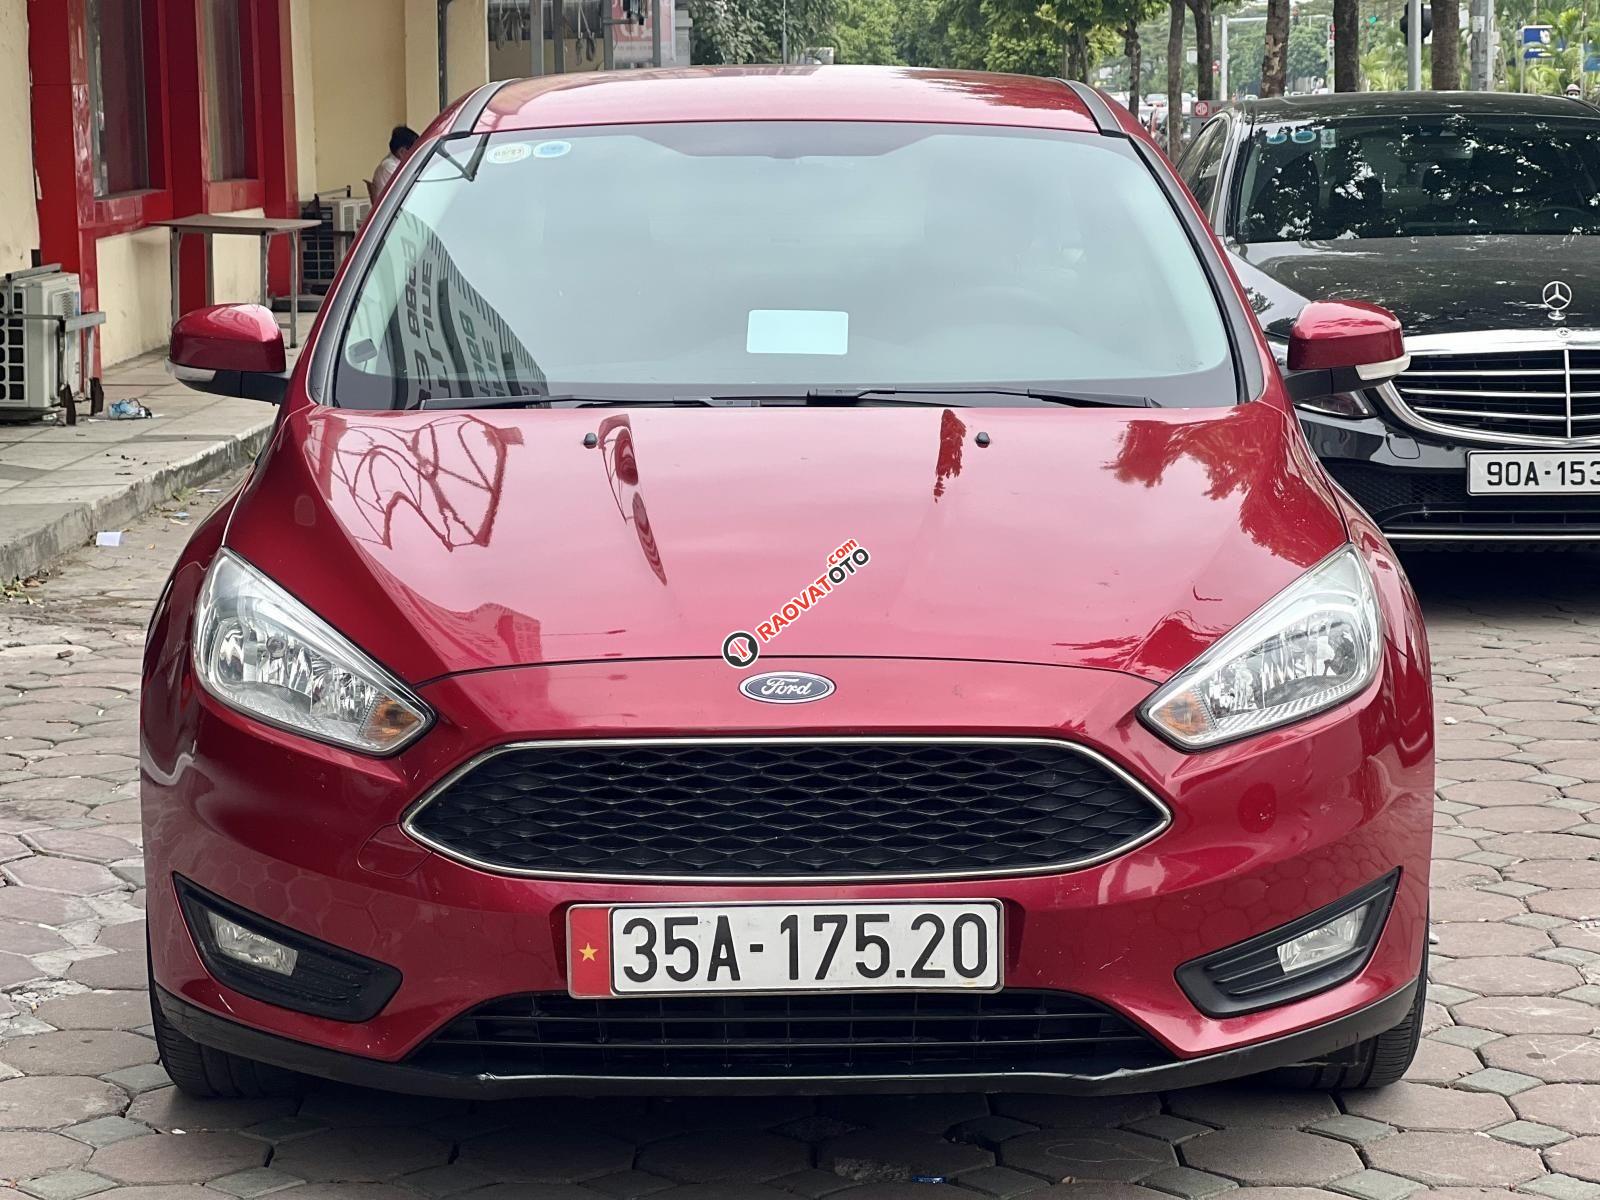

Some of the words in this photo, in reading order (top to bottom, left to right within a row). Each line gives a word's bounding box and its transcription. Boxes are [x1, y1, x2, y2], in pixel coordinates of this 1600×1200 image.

[1486, 460, 1600, 486] 90A-153
[760, 677, 812, 695] Ford
[622, 911, 988, 983] 35A-175.20
